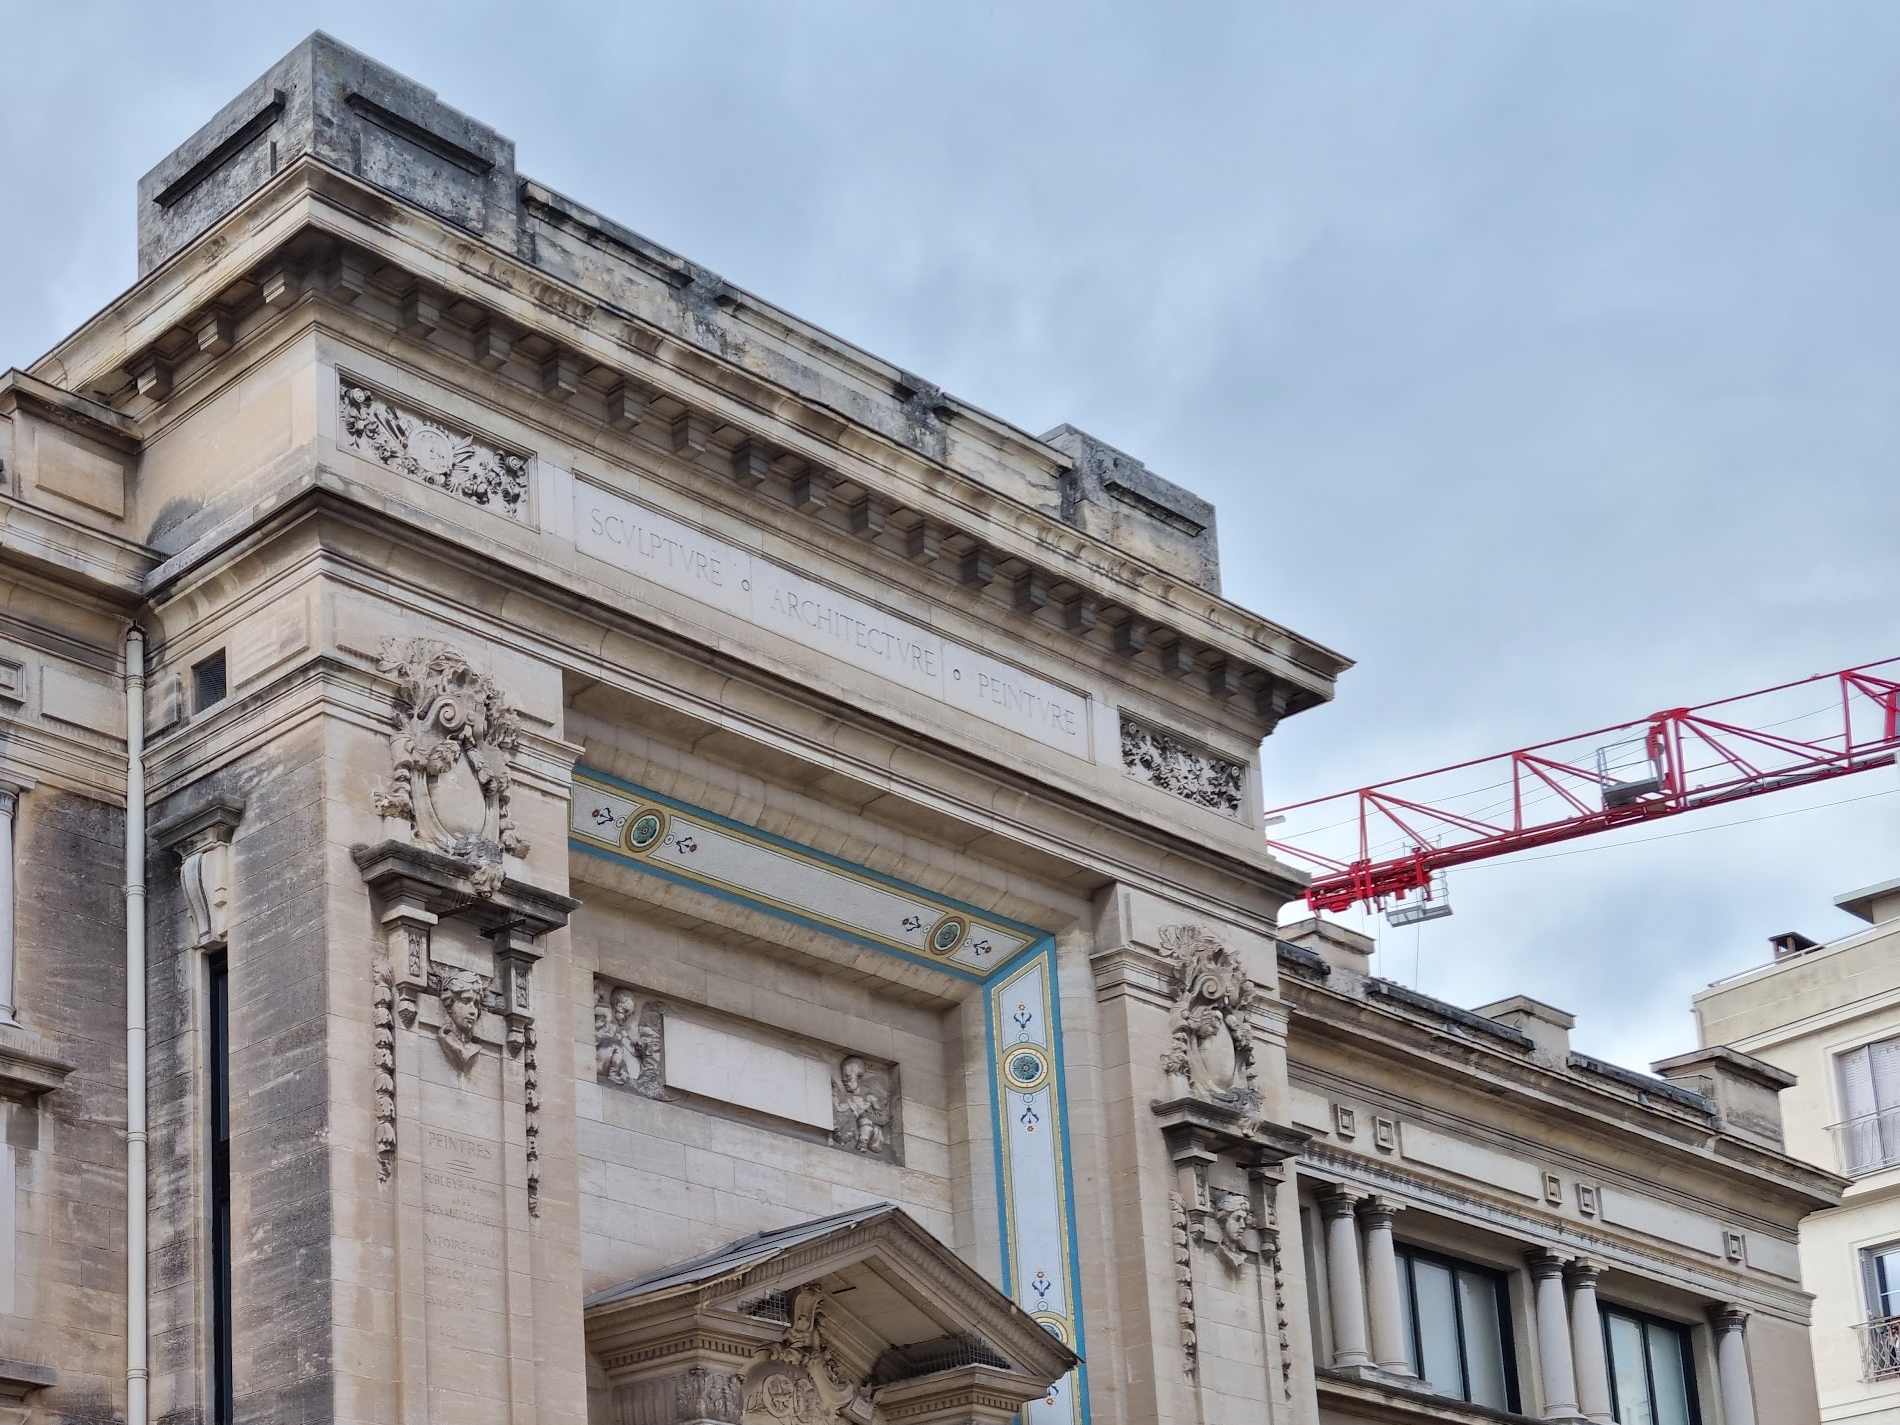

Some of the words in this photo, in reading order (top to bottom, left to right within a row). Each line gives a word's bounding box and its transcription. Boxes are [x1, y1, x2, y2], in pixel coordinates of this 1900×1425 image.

[591, 508, 722, 587] SCVLPTVRE
[770, 588, 936, 677] ARCHITECTVRE
[978, 671, 1076, 736] PEINTVRE
[428, 1131, 492, 1160] PEINTRES
